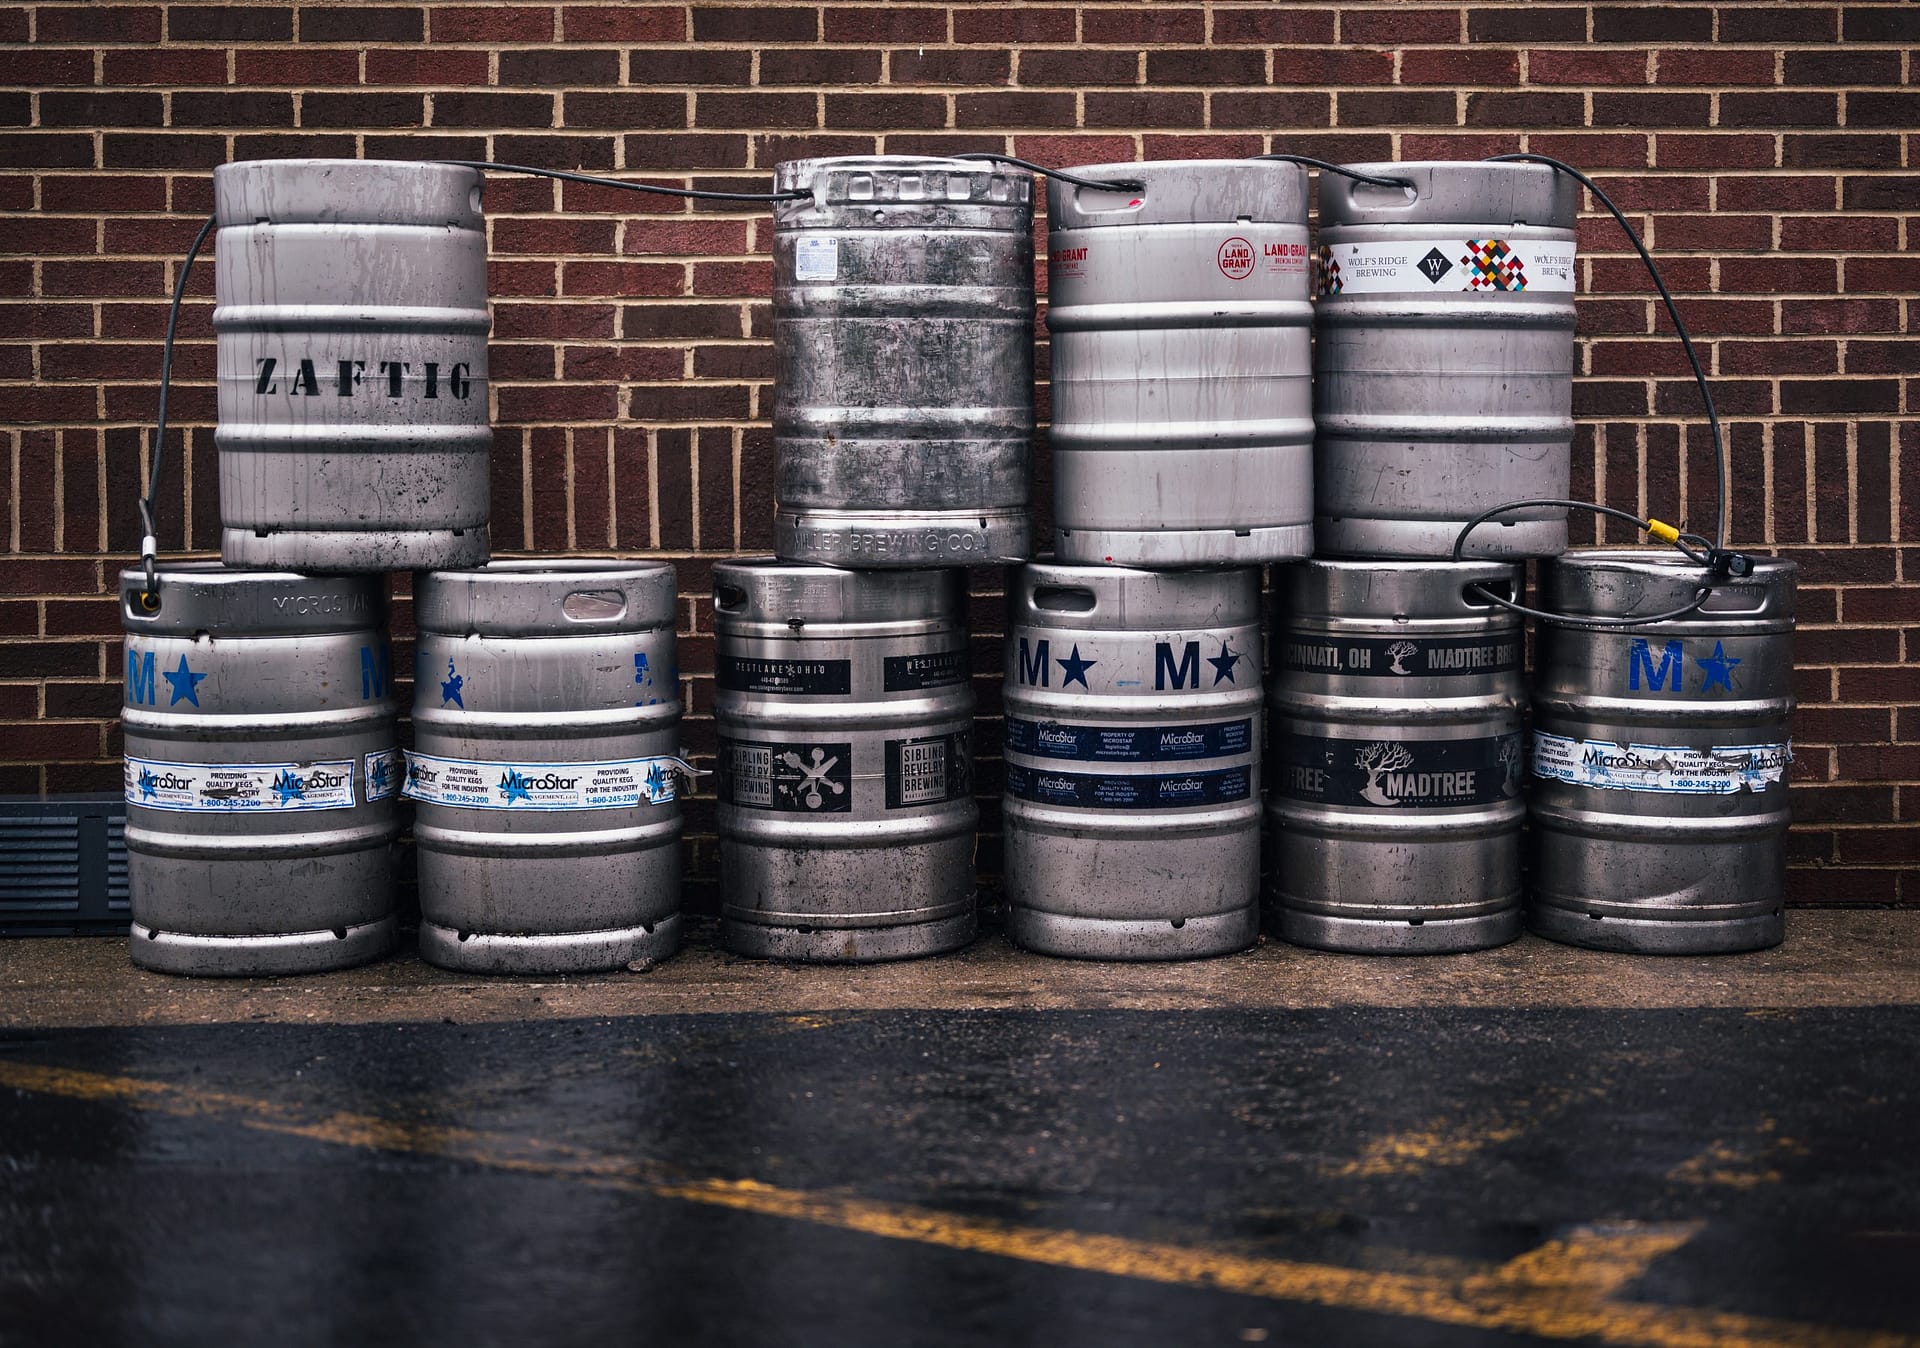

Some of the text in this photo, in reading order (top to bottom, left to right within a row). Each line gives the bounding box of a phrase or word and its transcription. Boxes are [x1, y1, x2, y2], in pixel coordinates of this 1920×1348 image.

[1225, 248, 1249, 258] LAND
[1222, 259, 1251, 268] GRANT
[1348, 256, 1408, 266] WOLF'S RIDGE
[1426, 258, 1444, 271] W
[1356, 268, 1397, 278] BREWING
[255, 358, 471, 400] ZAFTIG
[795, 533, 843, 550] MILLER
[850, 533, 939, 552] BREWING
[1019, 638, 1049, 687] M
[1348, 648, 1371, 669] OH
[1428, 646, 1494, 669] MADTREE
[1155, 640, 1200, 691] M
[1629, 638, 1683, 692] M
[128, 649, 155, 705] M
[360, 646, 390, 700] M
[1038, 729, 1077, 743] MicroStar
[1160, 731, 1204, 745] MicroStar
[904, 745, 944, 762] SIBLING
[1556, 749, 1569, 758] KEGS
[449, 766, 478, 776] PROVIDING
[597, 768, 629, 776] PROVIDING
[904, 760, 944, 777] REVELRY
[205, 780, 233, 788] QUALITY
[271, 771, 345, 790] MicoStar
[445, 775, 483, 784] QUALITY KEGS
[500, 770, 579, 790] MicroStar
[592, 777, 617, 786] QUALITY
[904, 775, 944, 792] BREWING
[1038, 776, 1076, 790] MicroStar
[1160, 778, 1204, 792] MicroStar
[1386, 771, 1476, 797] MADTREE
[1669, 779, 1731, 788] 1-800-245-2200
[461, 785, 488, 793] INDUSTRY
[585, 786, 599, 794] FOR
[600, 785, 610, 793] THE
[611, 784, 639, 793] INDUSTRY
[200, 799, 261, 807] 1-800-245-2200
[442, 793, 489, 804] 1-800-245-2200
[585, 793, 639, 804] 1-800-245-2200
